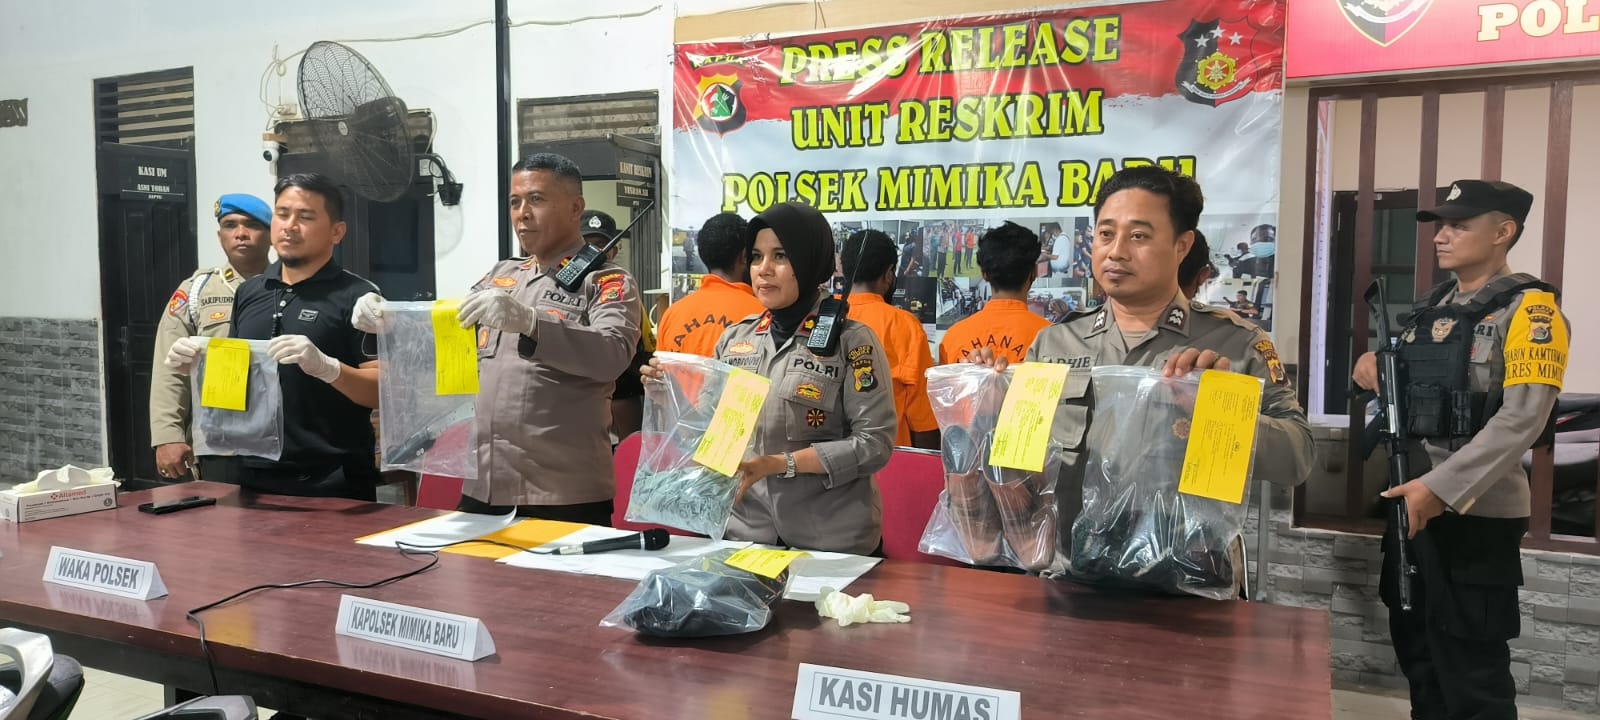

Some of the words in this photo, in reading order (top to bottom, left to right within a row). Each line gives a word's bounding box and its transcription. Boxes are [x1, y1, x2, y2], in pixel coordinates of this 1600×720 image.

[1477, 0, 1600, 42] POL
[778, 34, 910, 86] PRESS
[919, 14, 1121, 74] RELEASE
[791, 102, 889, 150] UNIT
[896, 89, 1105, 144] RESKRIM
[138, 166, 155, 176] KASI
[156, 168, 167, 177] UM
[721, 169, 868, 214] POLSEK
[875, 160, 1050, 213] MIMIKA
[1057, 155, 1198, 207] BA
[542, 290, 581, 306] POLRI
[670, 313, 733, 352] AHAN
[956, 334, 1025, 363] AHANA
[1475, 325, 1493, 336] RI
[793, 358, 839, 378] POLRI
[1506, 363, 1531, 379] LRES
[58, 556, 90, 581] WAKA
[92, 560, 140, 590] POLSEK
[351, 606, 399, 637] KAPOLSEK
[398, 615, 432, 644] MIMIKA
[433, 622, 460, 649] BARU
[818, 677, 882, 713] KASI
[889, 686, 991, 720] HUMAS
